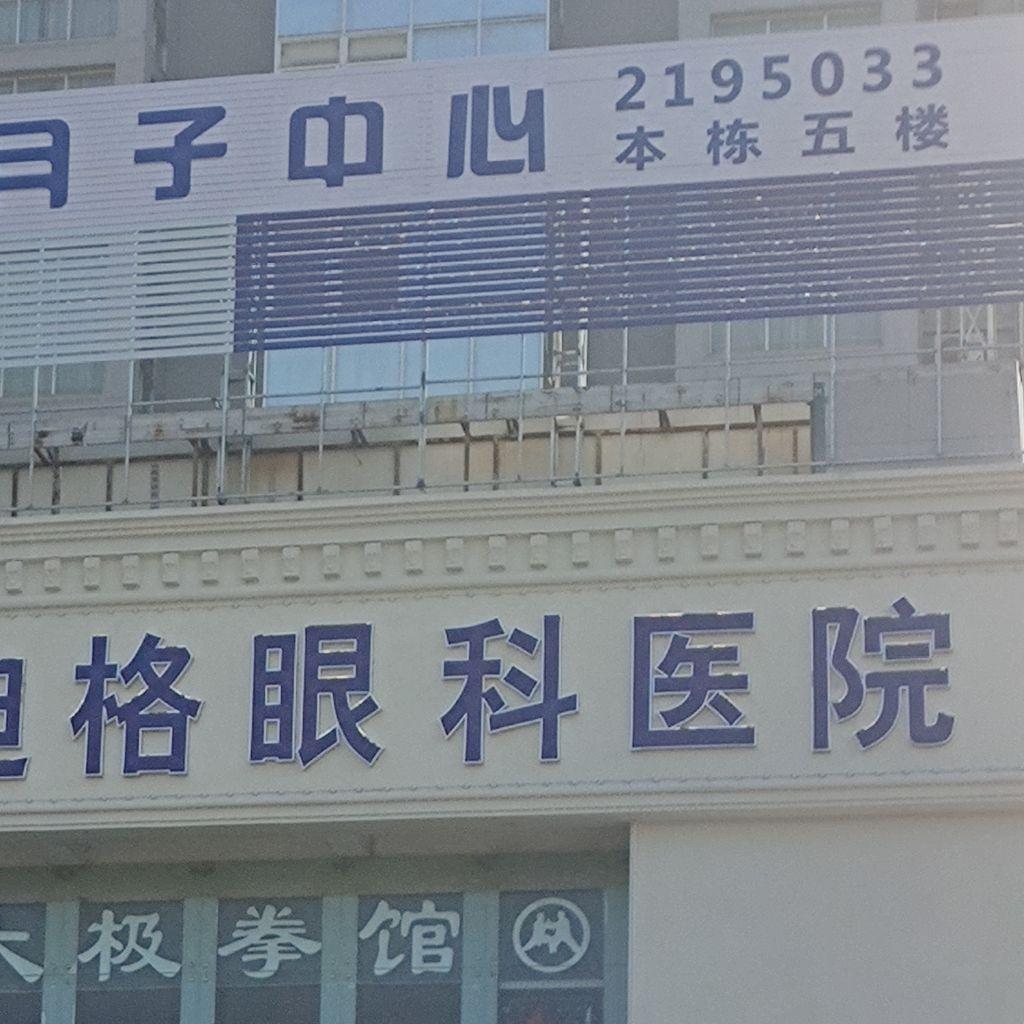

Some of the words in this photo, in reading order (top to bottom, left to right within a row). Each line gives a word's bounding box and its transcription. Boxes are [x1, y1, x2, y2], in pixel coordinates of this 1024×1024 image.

[615, 43, 943, 112] 2195033
[615, 103, 949, 171] 本栋五楼
